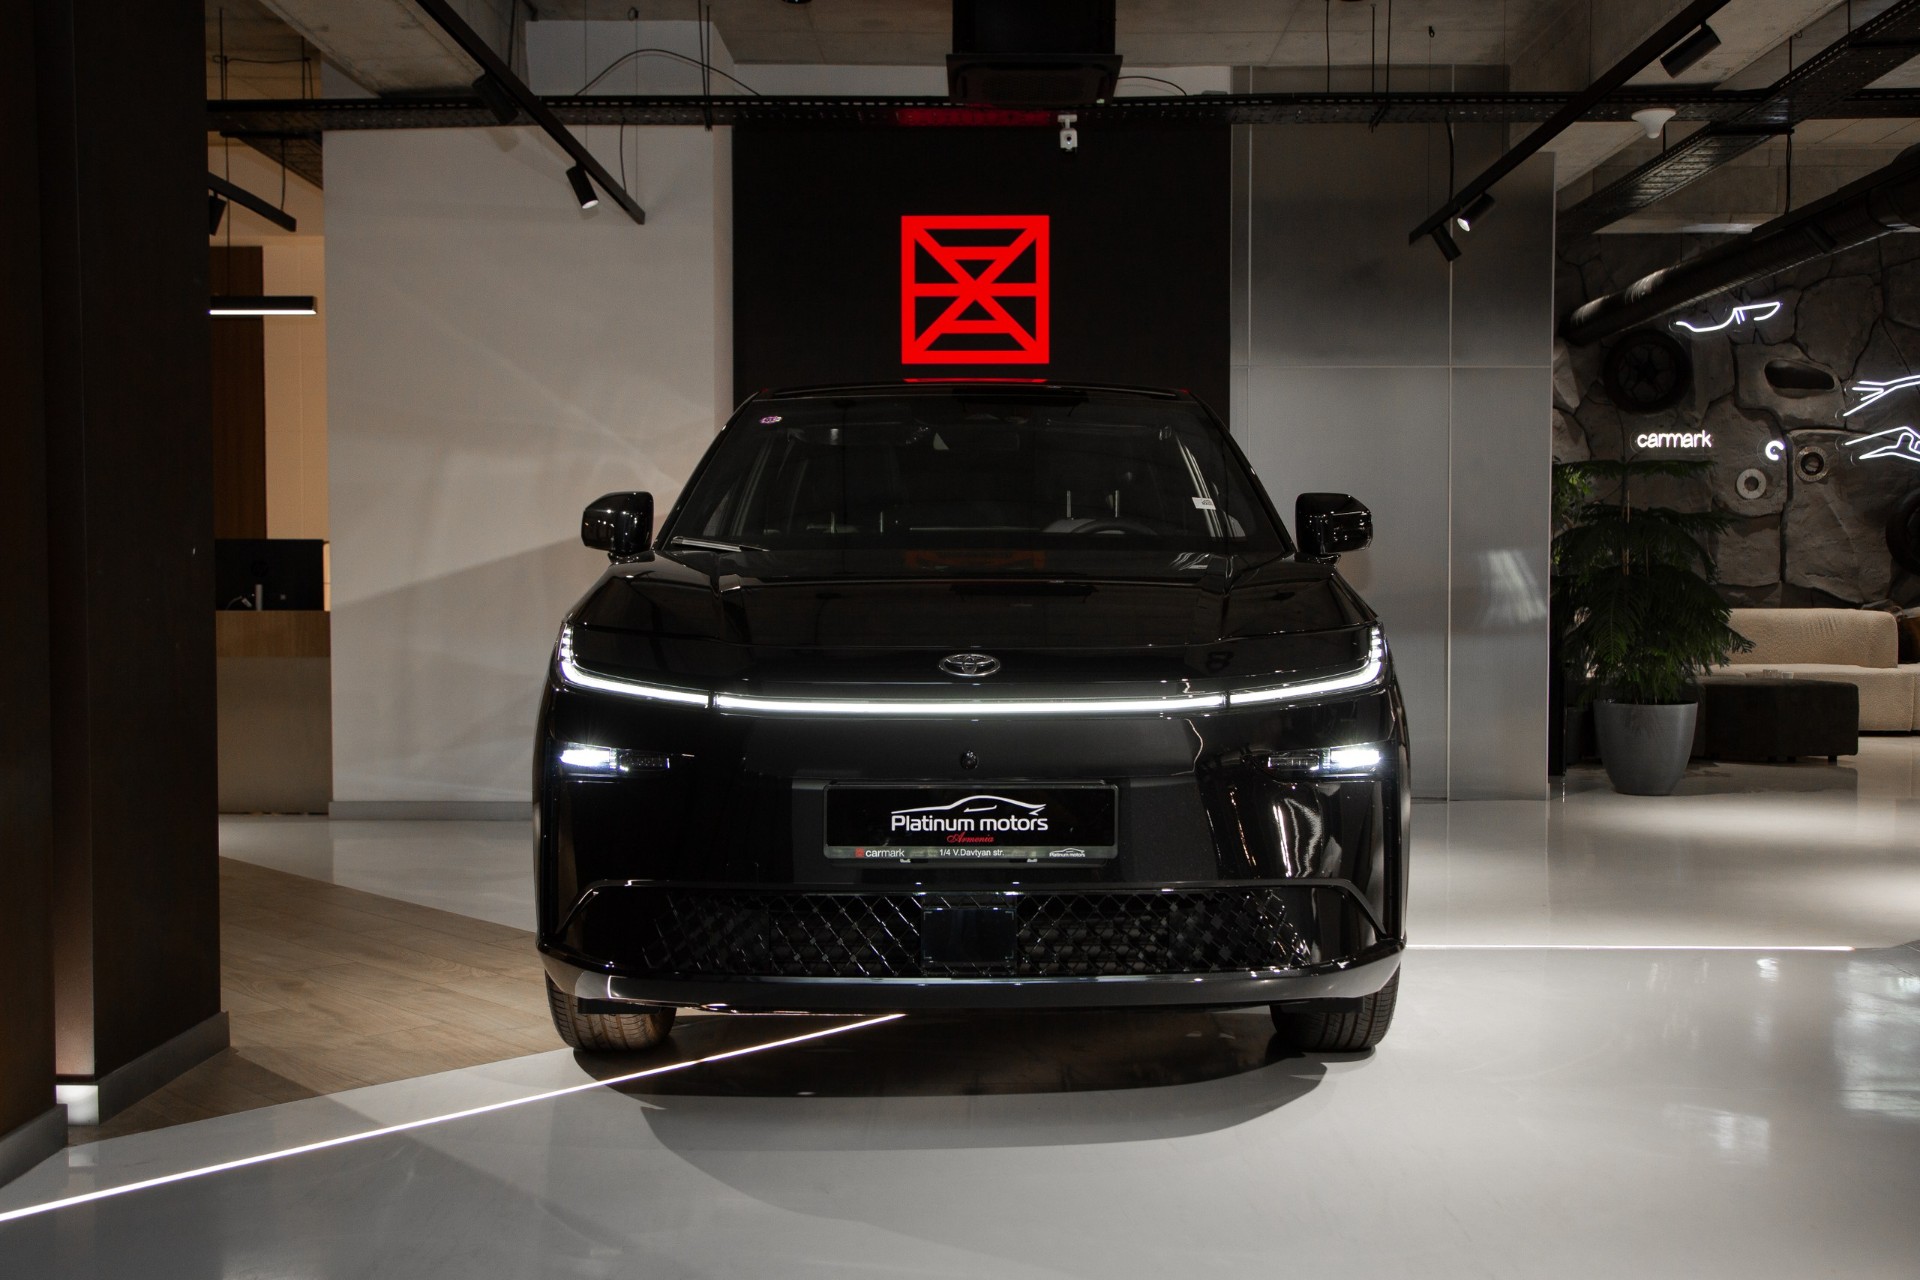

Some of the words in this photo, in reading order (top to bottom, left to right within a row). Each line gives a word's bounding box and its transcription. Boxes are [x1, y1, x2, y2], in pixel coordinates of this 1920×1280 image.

[1637, 429, 1712, 448] carmark
[891, 815, 975, 831] Platinum
[980, 815, 1048, 831] motors
[946, 832, 994, 843] Armenia
[865, 848, 905, 857] carmark
[939, 848, 951, 856] 1/4
[992, 848, 1005, 856] str.
